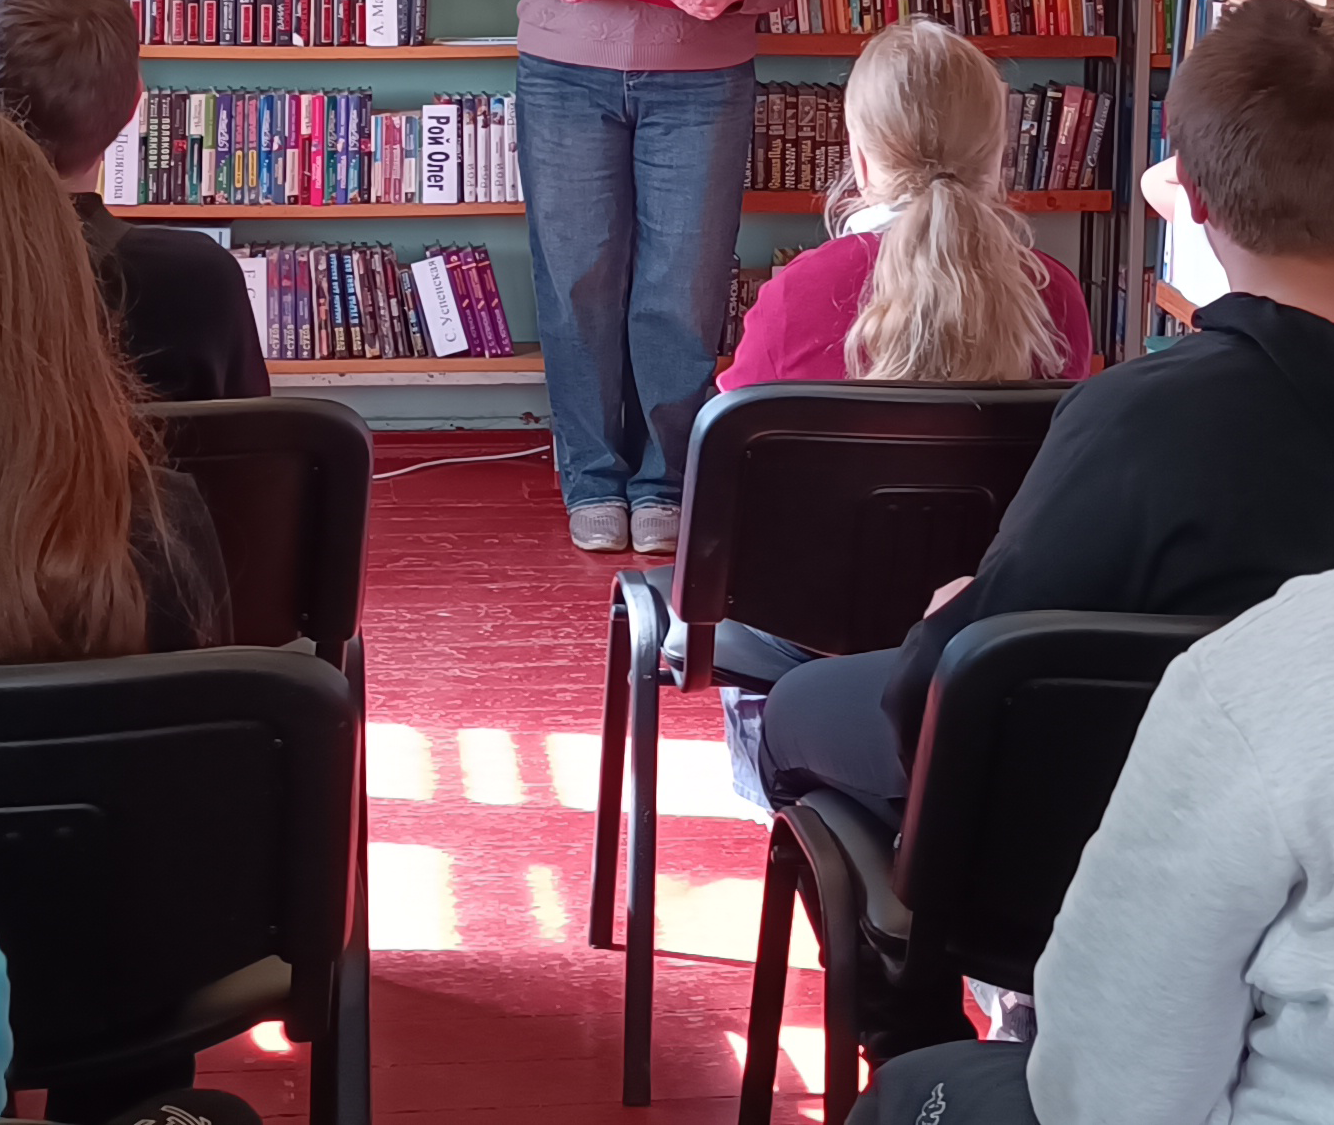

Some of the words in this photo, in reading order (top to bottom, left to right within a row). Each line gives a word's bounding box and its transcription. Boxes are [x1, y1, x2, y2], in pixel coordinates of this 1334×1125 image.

[373, 21, 385, 35] А.
[427, 115, 451, 145] Рой
[427, 151, 451, 191] Олег
[427, 259, 453, 327] Успенская
